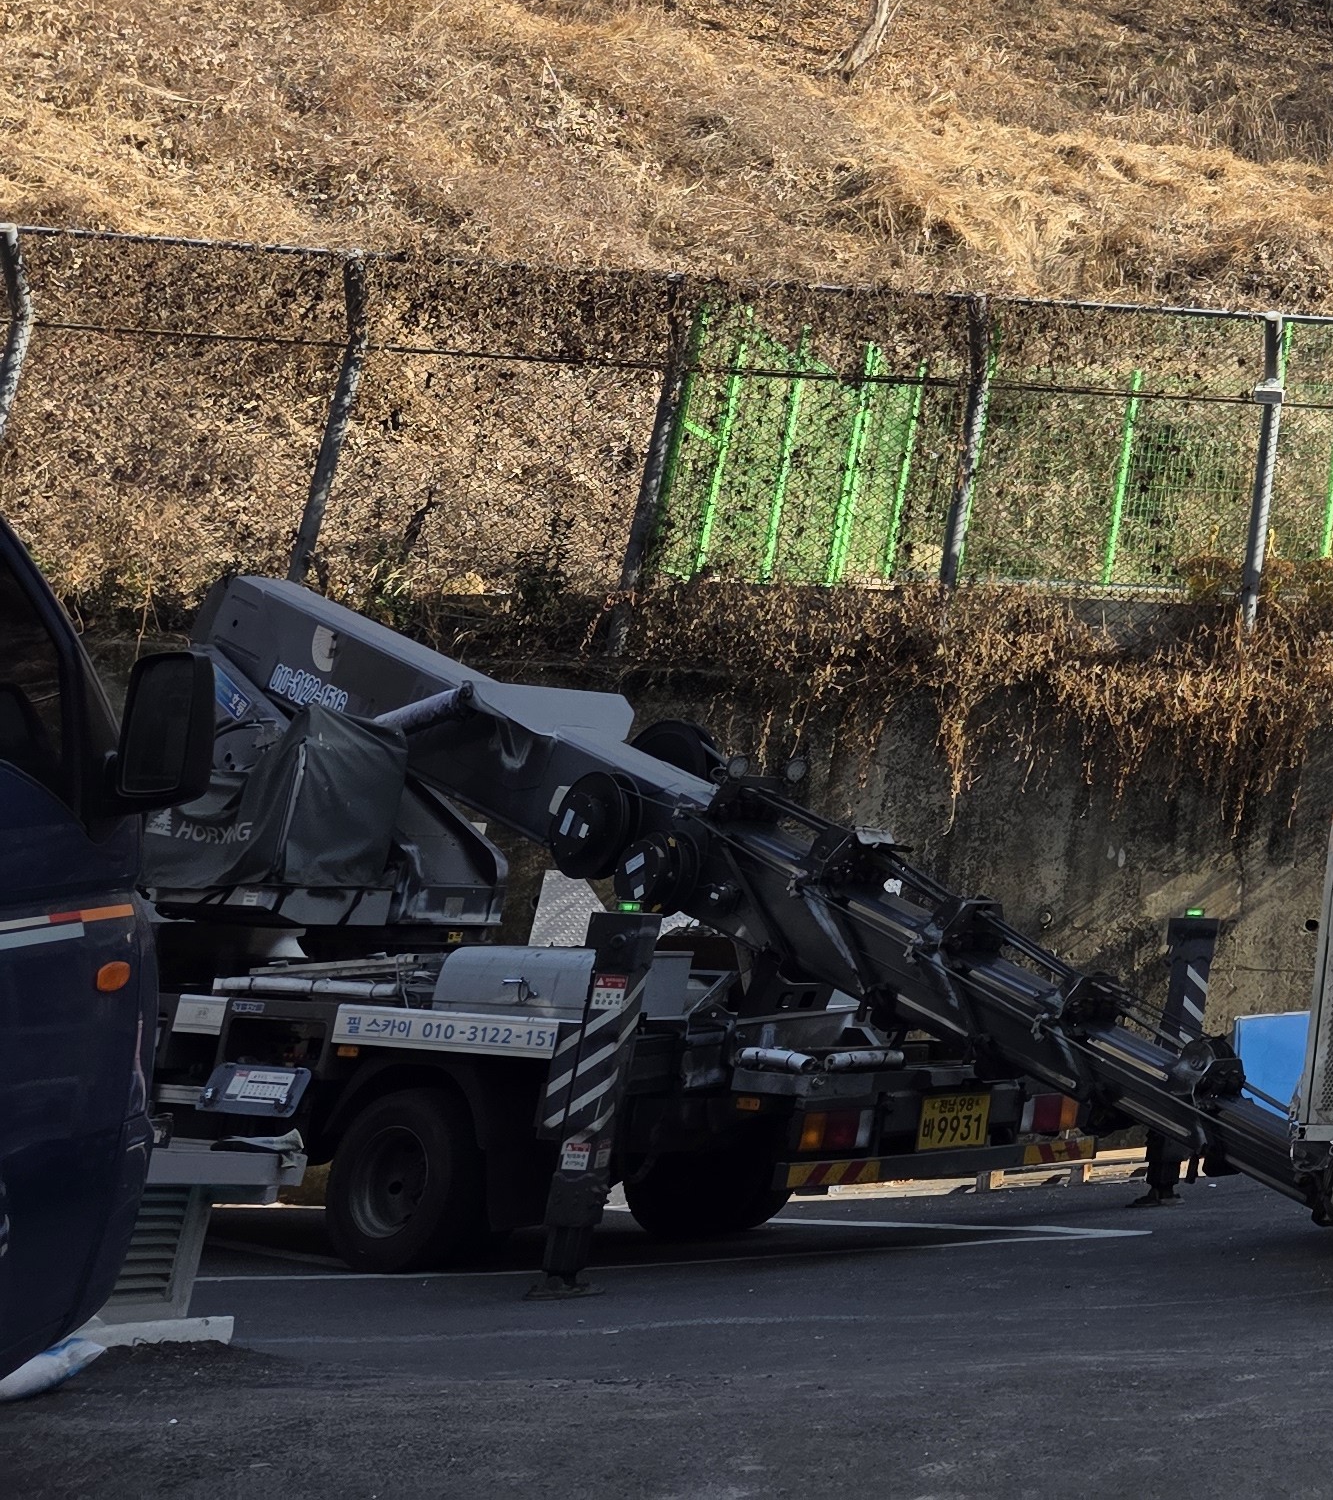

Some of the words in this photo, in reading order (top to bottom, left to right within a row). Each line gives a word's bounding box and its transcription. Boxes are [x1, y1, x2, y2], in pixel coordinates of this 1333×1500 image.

[346, 1016, 362, 1034] 필
[365, 1018, 412, 1038] 스카이
[939, 1099, 957, 1114] 전남
[959, 1097, 974, 1112] 98
[937, 1113, 982, 1144] 9931
